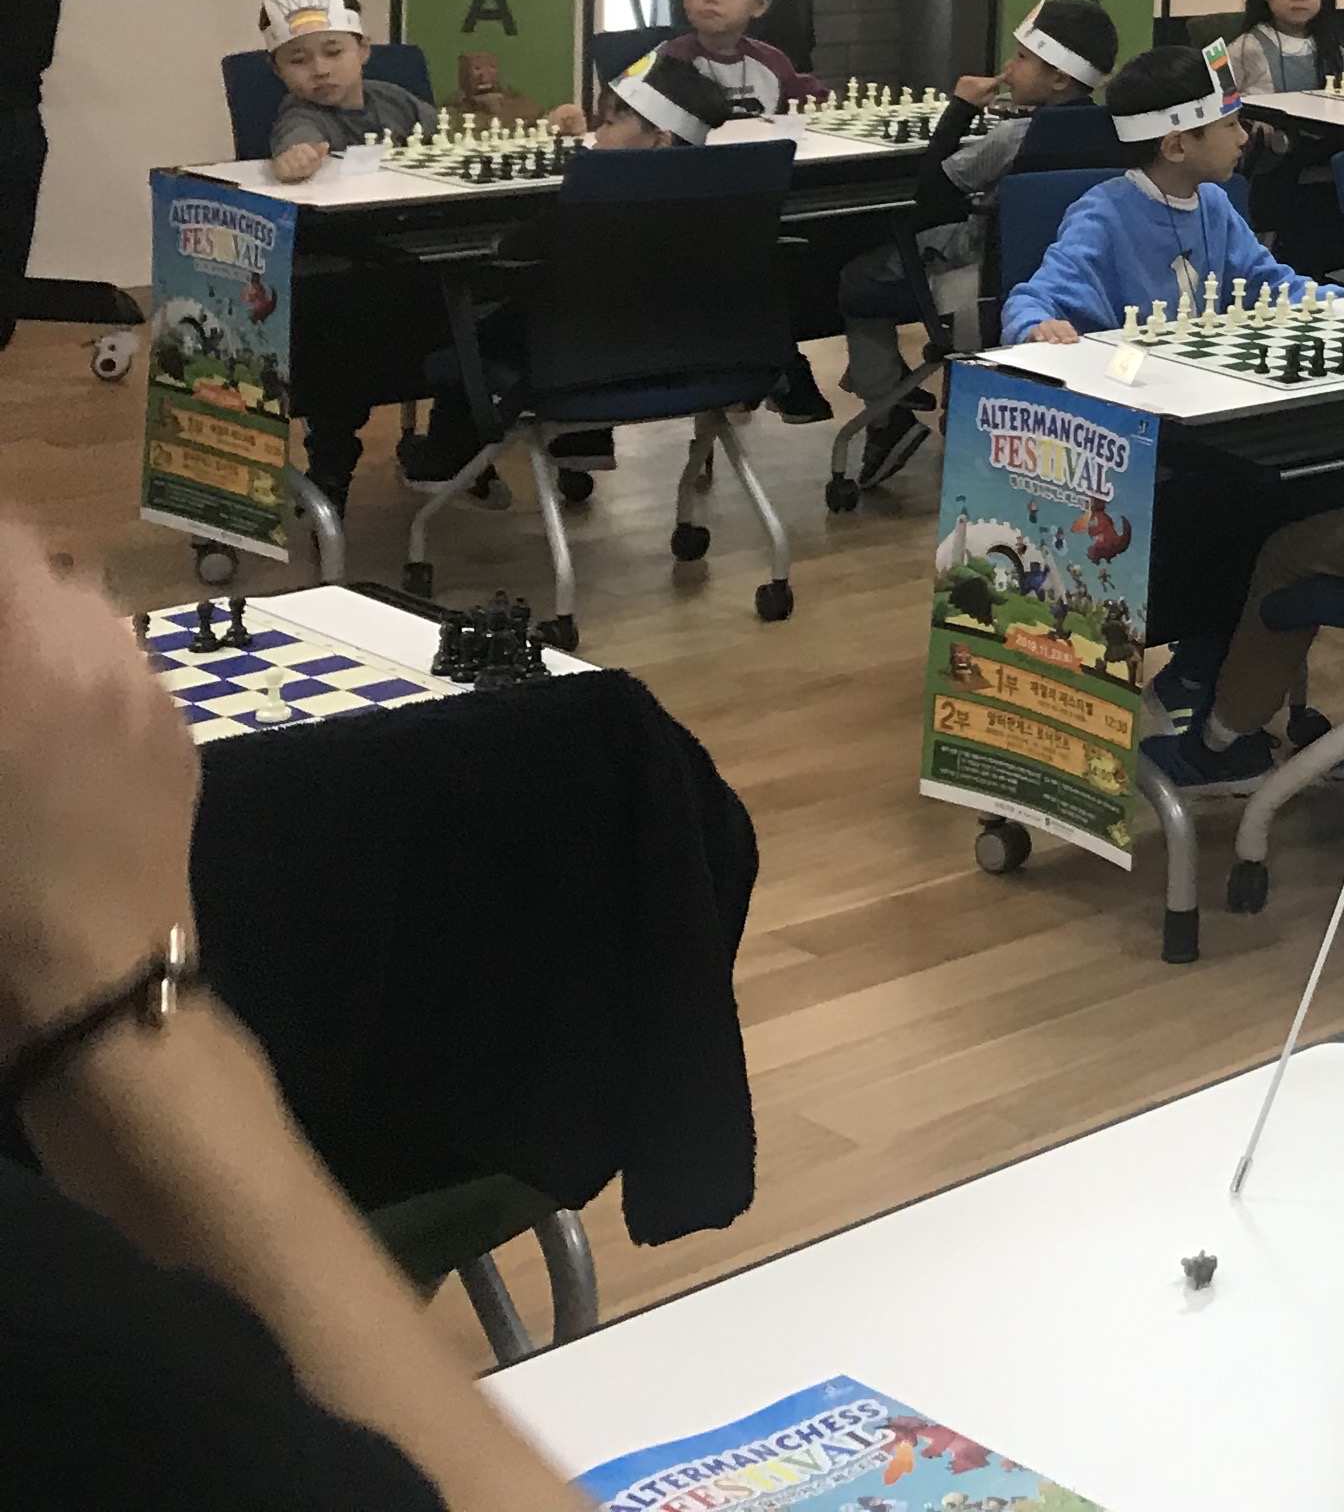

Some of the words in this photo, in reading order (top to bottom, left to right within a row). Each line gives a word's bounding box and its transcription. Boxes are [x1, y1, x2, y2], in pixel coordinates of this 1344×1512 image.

[182, 227, 263, 271] FESVAL
[993, 434, 1112, 496] FESTIVAL
[940, 700, 971, 732] 2부
[660, 1428, 895, 1512] FESTIVAL
